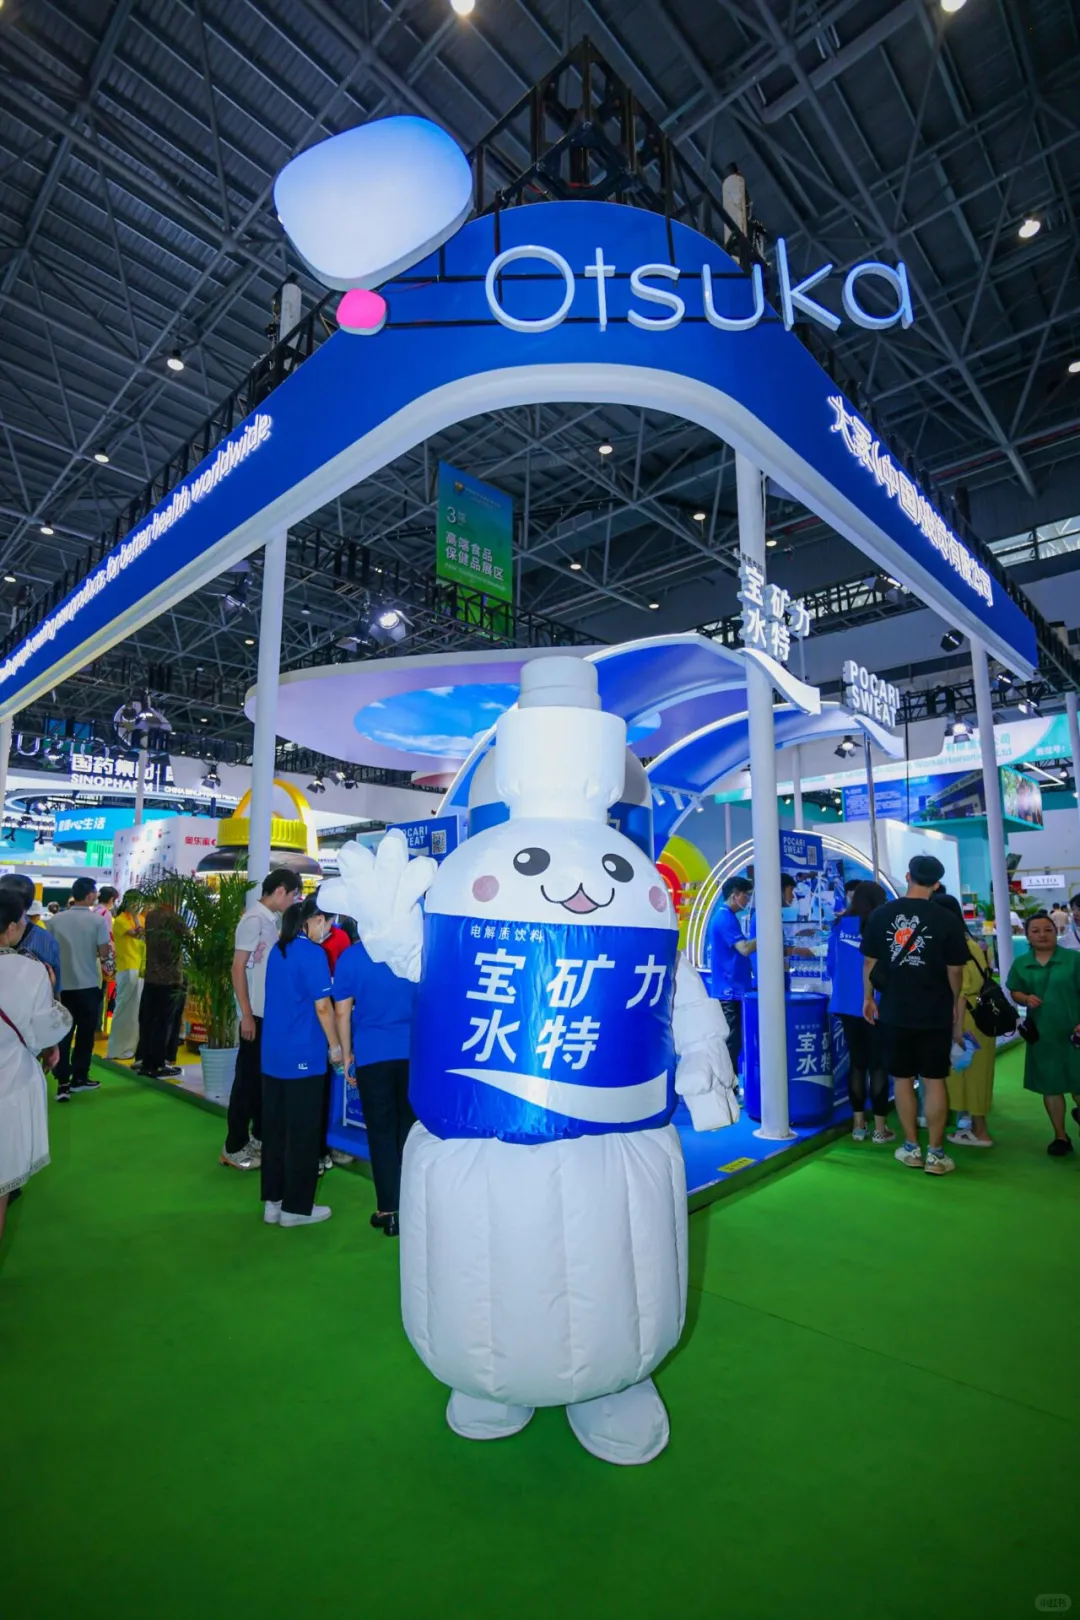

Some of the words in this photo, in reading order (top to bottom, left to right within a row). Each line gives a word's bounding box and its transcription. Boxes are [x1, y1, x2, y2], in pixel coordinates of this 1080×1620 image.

[485, 238, 913, 333] Otsuka
[118, 523, 155, 571] better
[151, 485, 192, 541] health
[190, 413, 272, 504] worldwide
[445, 531, 494, 562] 高端食品
[445, 546, 505, 582] 保健品展区
[849, 660, 901, 709] POCARI
[850, 686, 898, 729] SWEAT
[404, 825, 428, 838] OCARI
[783, 836, 806, 847] POCARI
[783, 844, 804, 855] SWEAT
[470, 923, 544, 943] 电解质饮料
[466, 948, 667, 1011] 宝矿力
[461, 1009, 601, 1071] 水特
